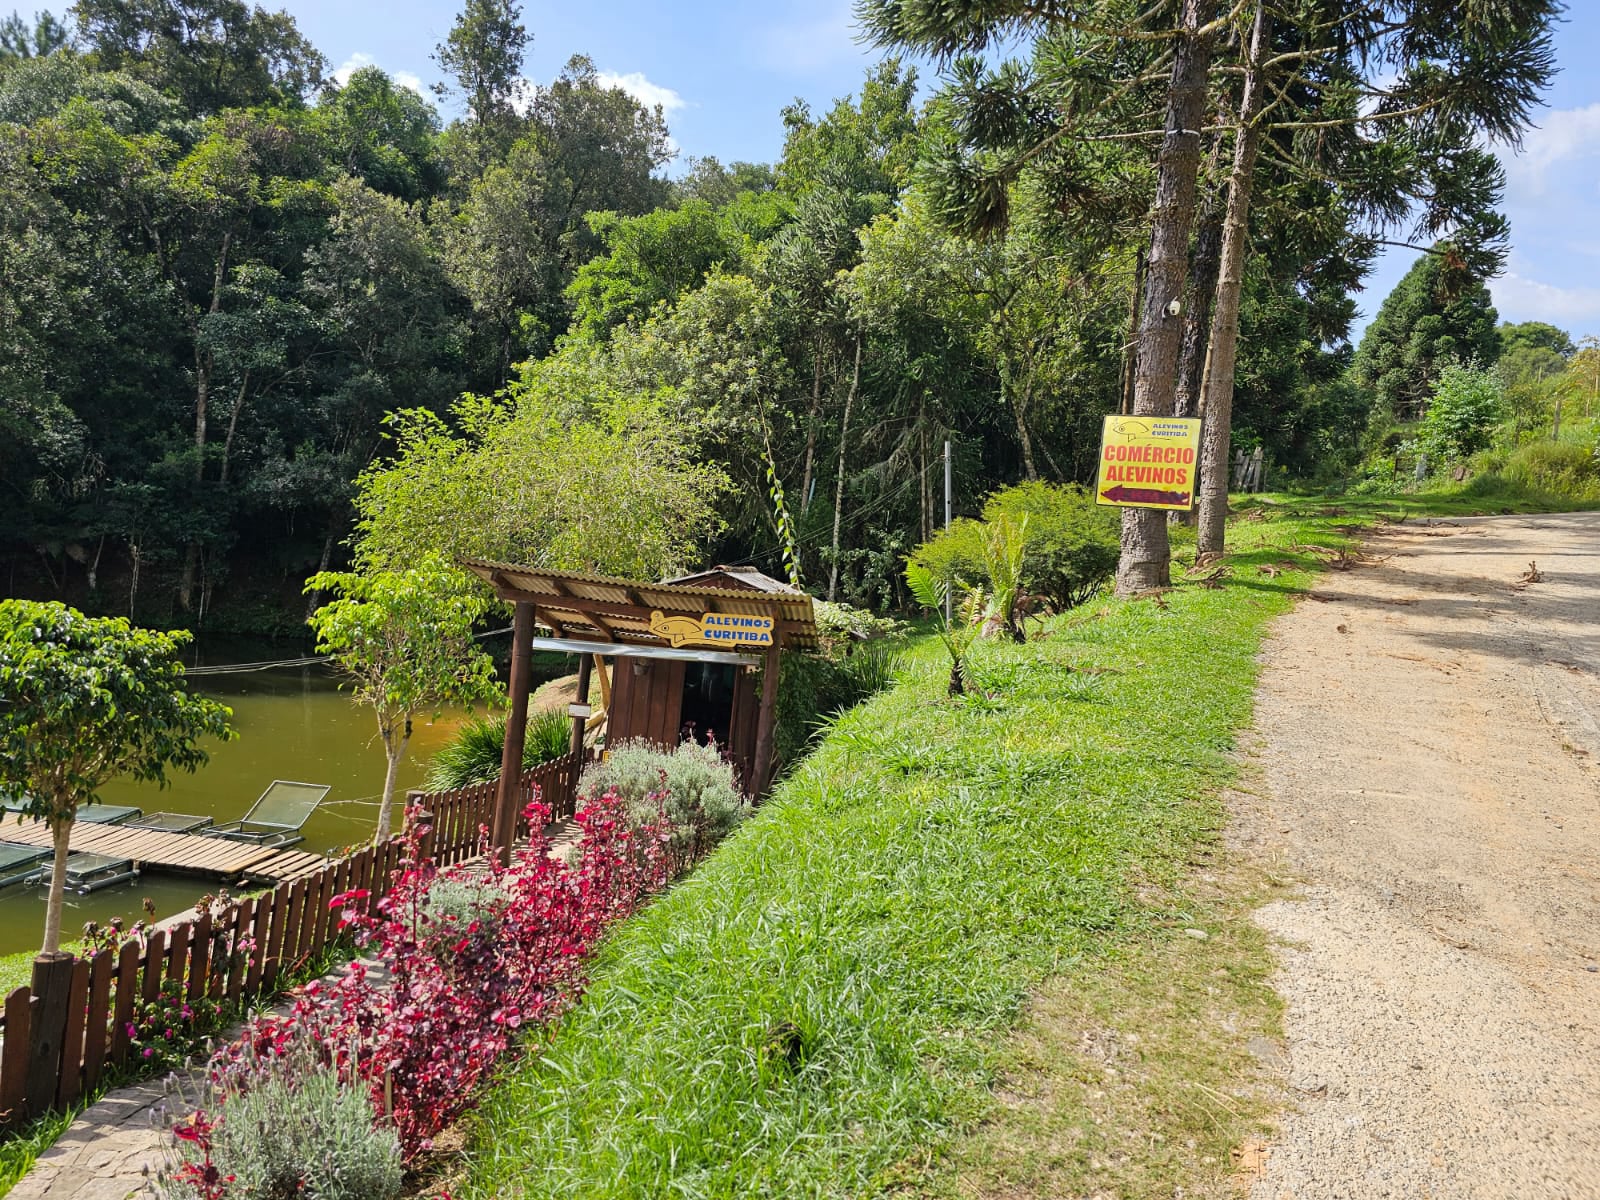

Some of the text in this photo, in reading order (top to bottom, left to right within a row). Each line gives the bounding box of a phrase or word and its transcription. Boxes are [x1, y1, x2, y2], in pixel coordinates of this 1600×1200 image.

[1104, 444, 1194, 464] COMÉRCIO
[1106, 465, 1187, 485] ALEVINOS
[706, 616, 770, 628] ALEVINOS
[704, 629, 769, 641] CURITIBA
